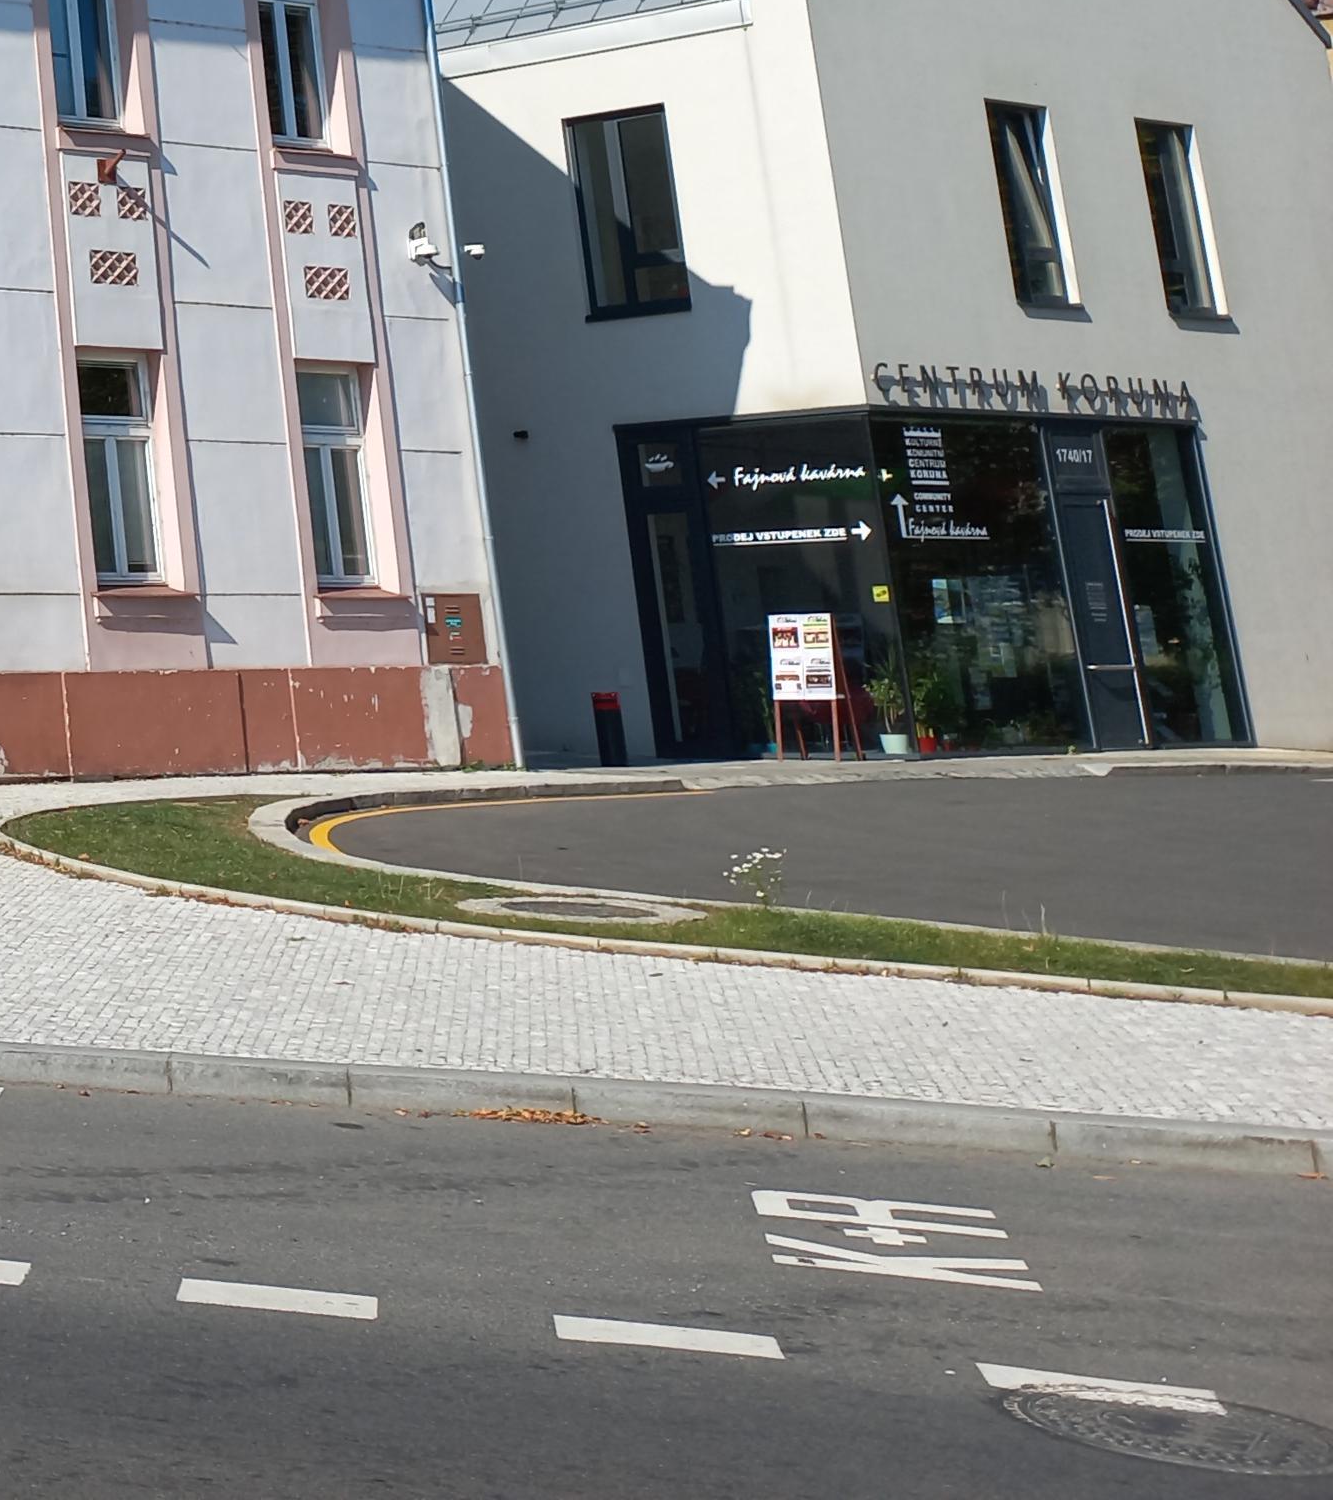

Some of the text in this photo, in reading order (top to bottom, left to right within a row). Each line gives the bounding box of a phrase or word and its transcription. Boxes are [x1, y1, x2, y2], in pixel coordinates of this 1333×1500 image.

[874, 362, 1193, 403] CENTRUM KORUNA
[1056, 448, 1092, 463] 1740/17
[909, 459, 946, 468] CENTRUM
[734, 463, 866, 491] Fajnová kavárna
[910, 469, 948, 479] KORUNA
[915, 504, 954, 513] CENTER
[713, 527, 846, 542] PRODEJ VSTUPENEK ZDE
